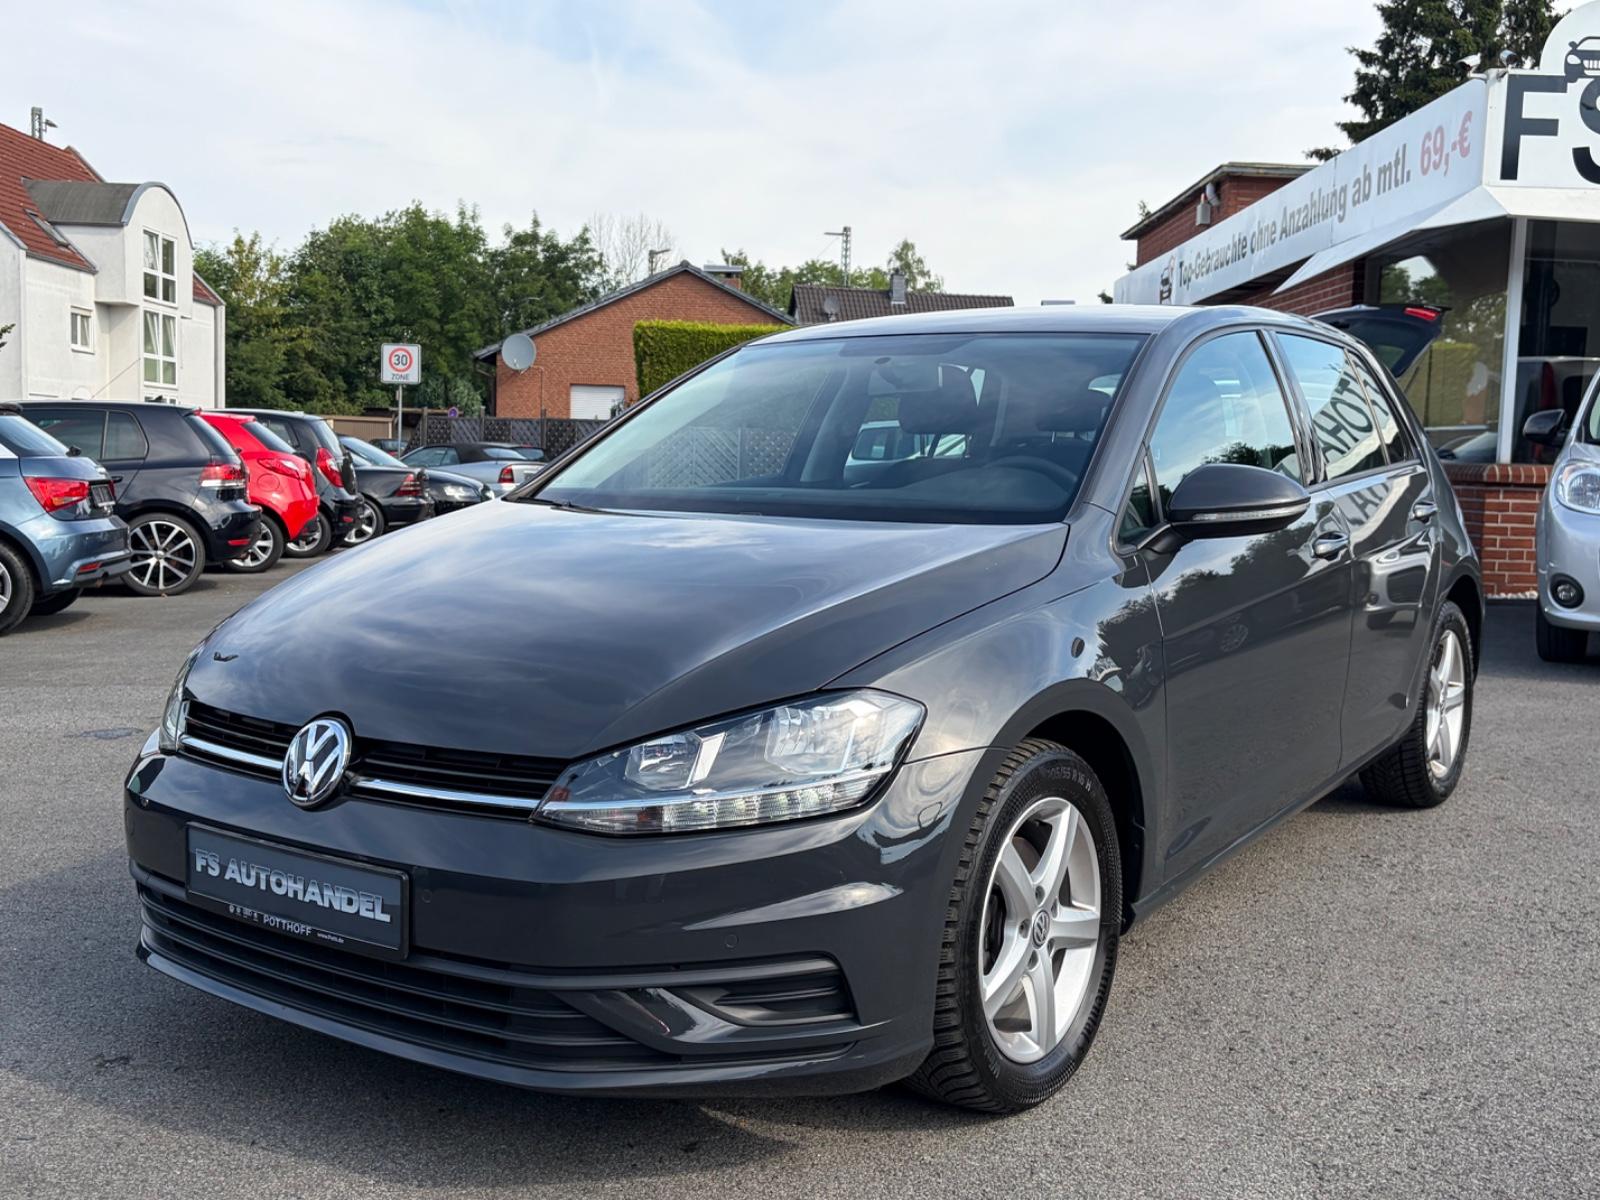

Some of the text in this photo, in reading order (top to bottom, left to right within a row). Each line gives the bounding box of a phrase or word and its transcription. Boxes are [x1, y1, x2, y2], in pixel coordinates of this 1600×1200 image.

[1500, 74, 1600, 185] F
[1178, 110, 1473, 290] Top-Gebrauchte ohne Anzahlung ab mtl. 69,-€
[393, 354, 408, 366] 30
[195, 848, 391, 923] FS AUTOHANDEL
[263, 914, 313, 936] POTTHOFF
